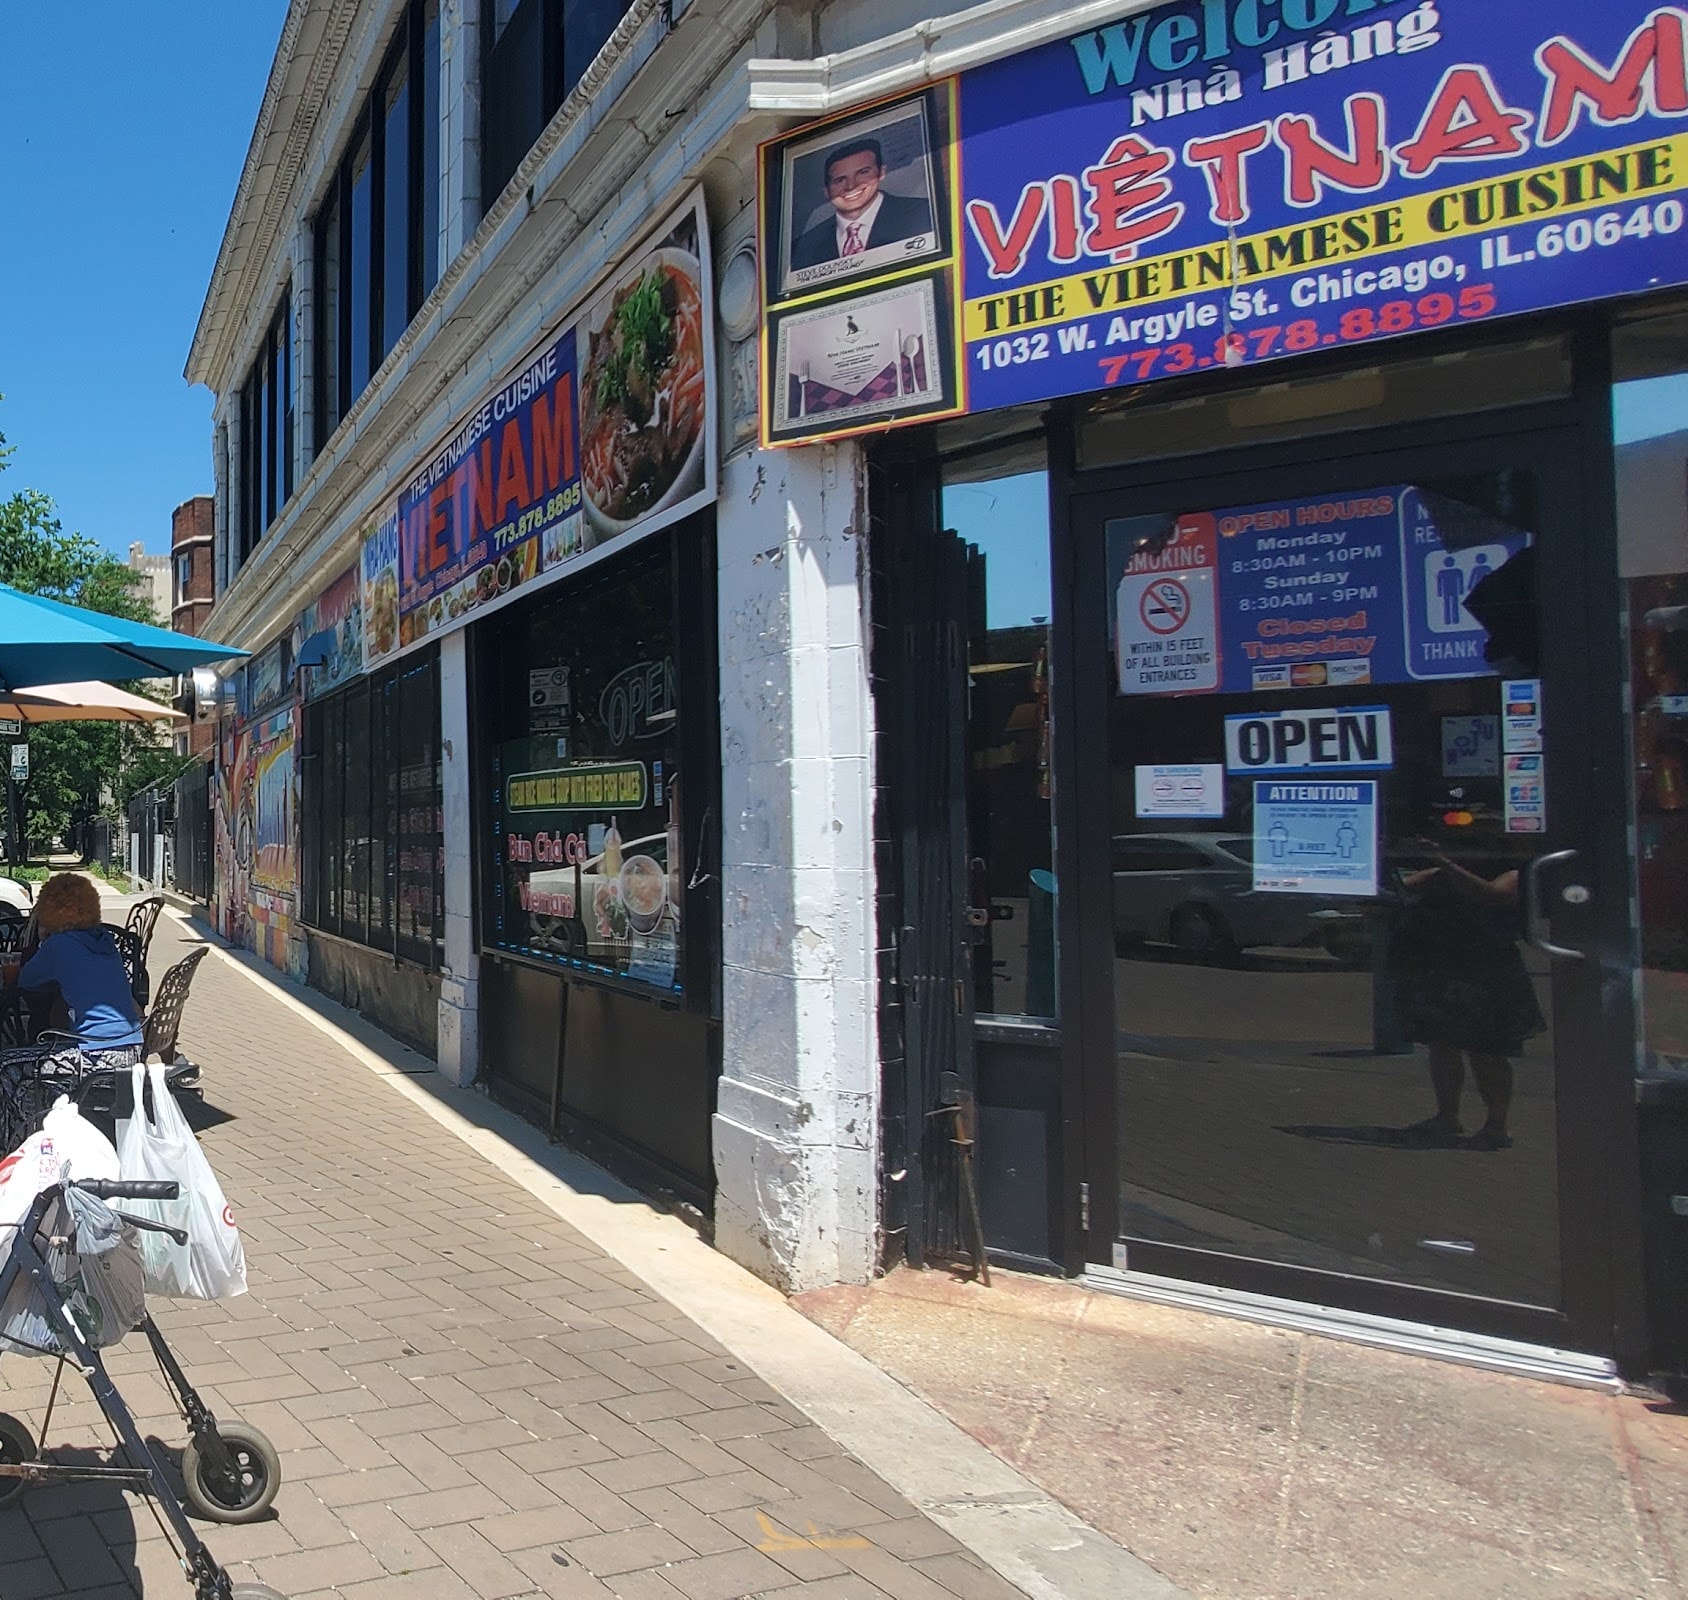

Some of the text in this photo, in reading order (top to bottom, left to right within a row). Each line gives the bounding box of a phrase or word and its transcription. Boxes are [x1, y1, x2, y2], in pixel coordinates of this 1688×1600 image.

[1130, 1, 1442, 128] Nhà Hàng
[978, 145, 1674, 332] THE VIETNAMESE CUISINE
[976, 199, 1685, 371] 1032 W. Argyle St. Chicago, IL.60640
[1098, 283, 1498, 385] 773.878.8895
[411, 347, 558, 503] THE VIETNAMESE CUISINE
[399, 371, 575, 591] VIETNAM
[493, 481, 582, 552] 773.878.8895
[1218, 508, 1290, 535] OPEN
[1296, 495, 1395, 526] HOURS
[1256, 531, 1347, 551] Monday
[1232, 553, 1306, 574] 8:30AM
[1326, 545, 1383, 563] 10PM
[1264, 571, 1350, 589] Sunday
[1239, 592, 1313, 611] 8:30AM
[1332, 586, 1378, 602] 9PM
[1258, 610, 1367, 637] Closed
[1130, 637, 1205, 654] WITHIN 15 FEET
[1240, 634, 1377, 660] Tuesday
[1421, 640, 1478, 661] THANK
[1125, 653, 1211, 670] OF ALL BUILDING
[1139, 669, 1197, 684] ENTRANCES
[1237, 714, 1377, 767] OPEN
[1269, 786, 1359, 801] ATTENTION
